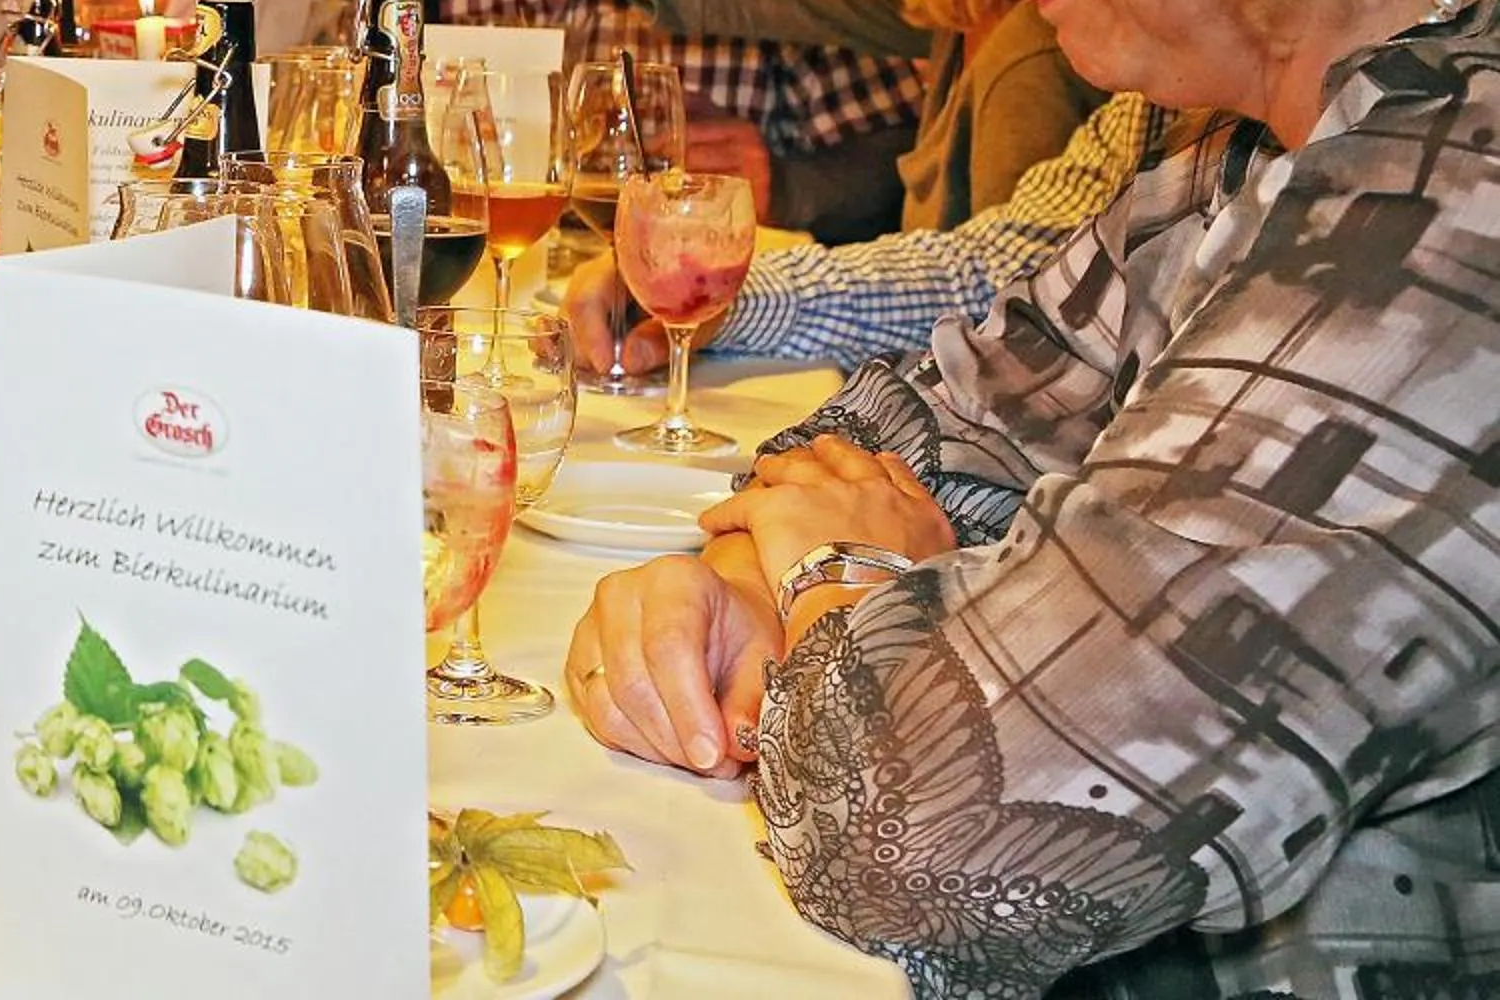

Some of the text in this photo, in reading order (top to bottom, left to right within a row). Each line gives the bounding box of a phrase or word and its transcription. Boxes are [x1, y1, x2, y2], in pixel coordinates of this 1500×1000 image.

[145, 412, 213, 452] Grosch
[161, 390, 200, 420] Der
[33, 488, 338, 572] Herzlich Willkommen
[38, 540, 329, 620] zum Bierkulinarium
[78, 886, 109, 906] am
[233, 925, 294, 956] 2015
